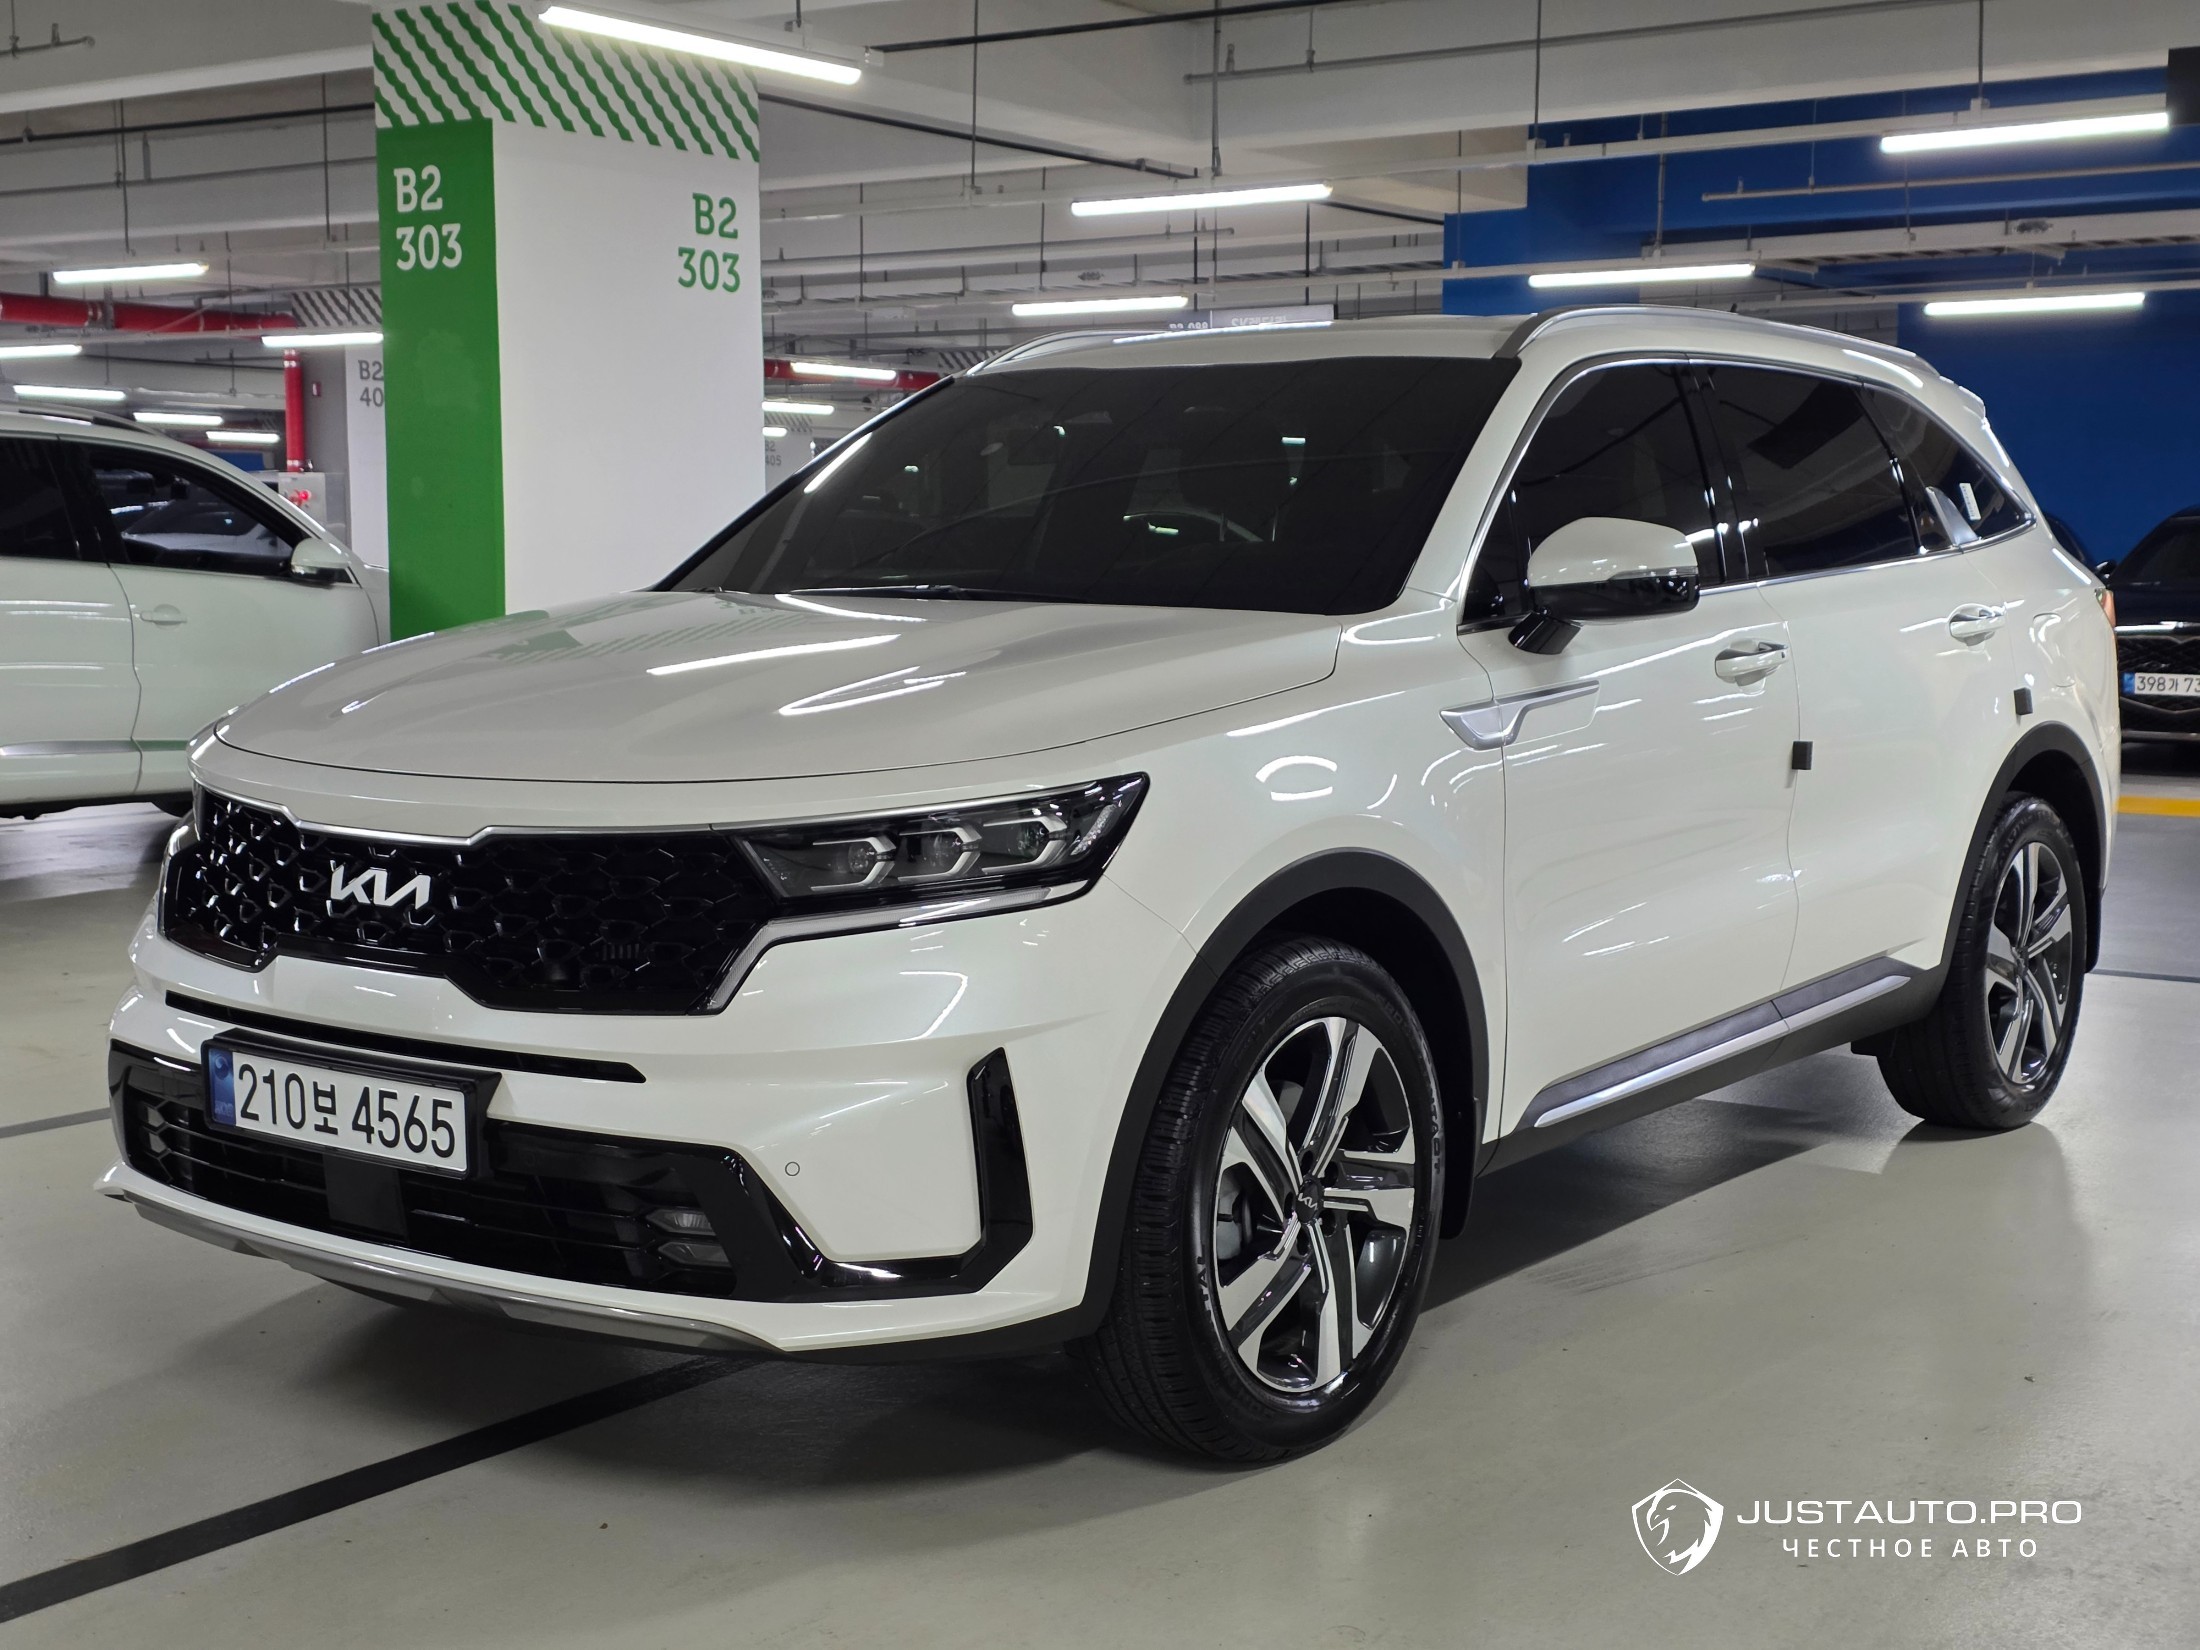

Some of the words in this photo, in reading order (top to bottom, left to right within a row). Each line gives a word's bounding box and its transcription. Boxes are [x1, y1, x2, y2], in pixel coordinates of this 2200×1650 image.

[394, 165, 443, 213] B2
[692, 192, 738, 240] B2
[396, 223, 462, 270] 303
[678, 246, 740, 292] 303
[358, 360, 384, 381] B2
[359, 386, 384, 407] 40
[2137, 676, 2178, 692] 398가
[2184, 677, 2200, 693] 73
[330, 864, 431, 910] KIA
[238, 1063, 339, 1136] 210보
[352, 1086, 456, 1158] 4565
[1298, 1193, 1318, 1211] KIA
